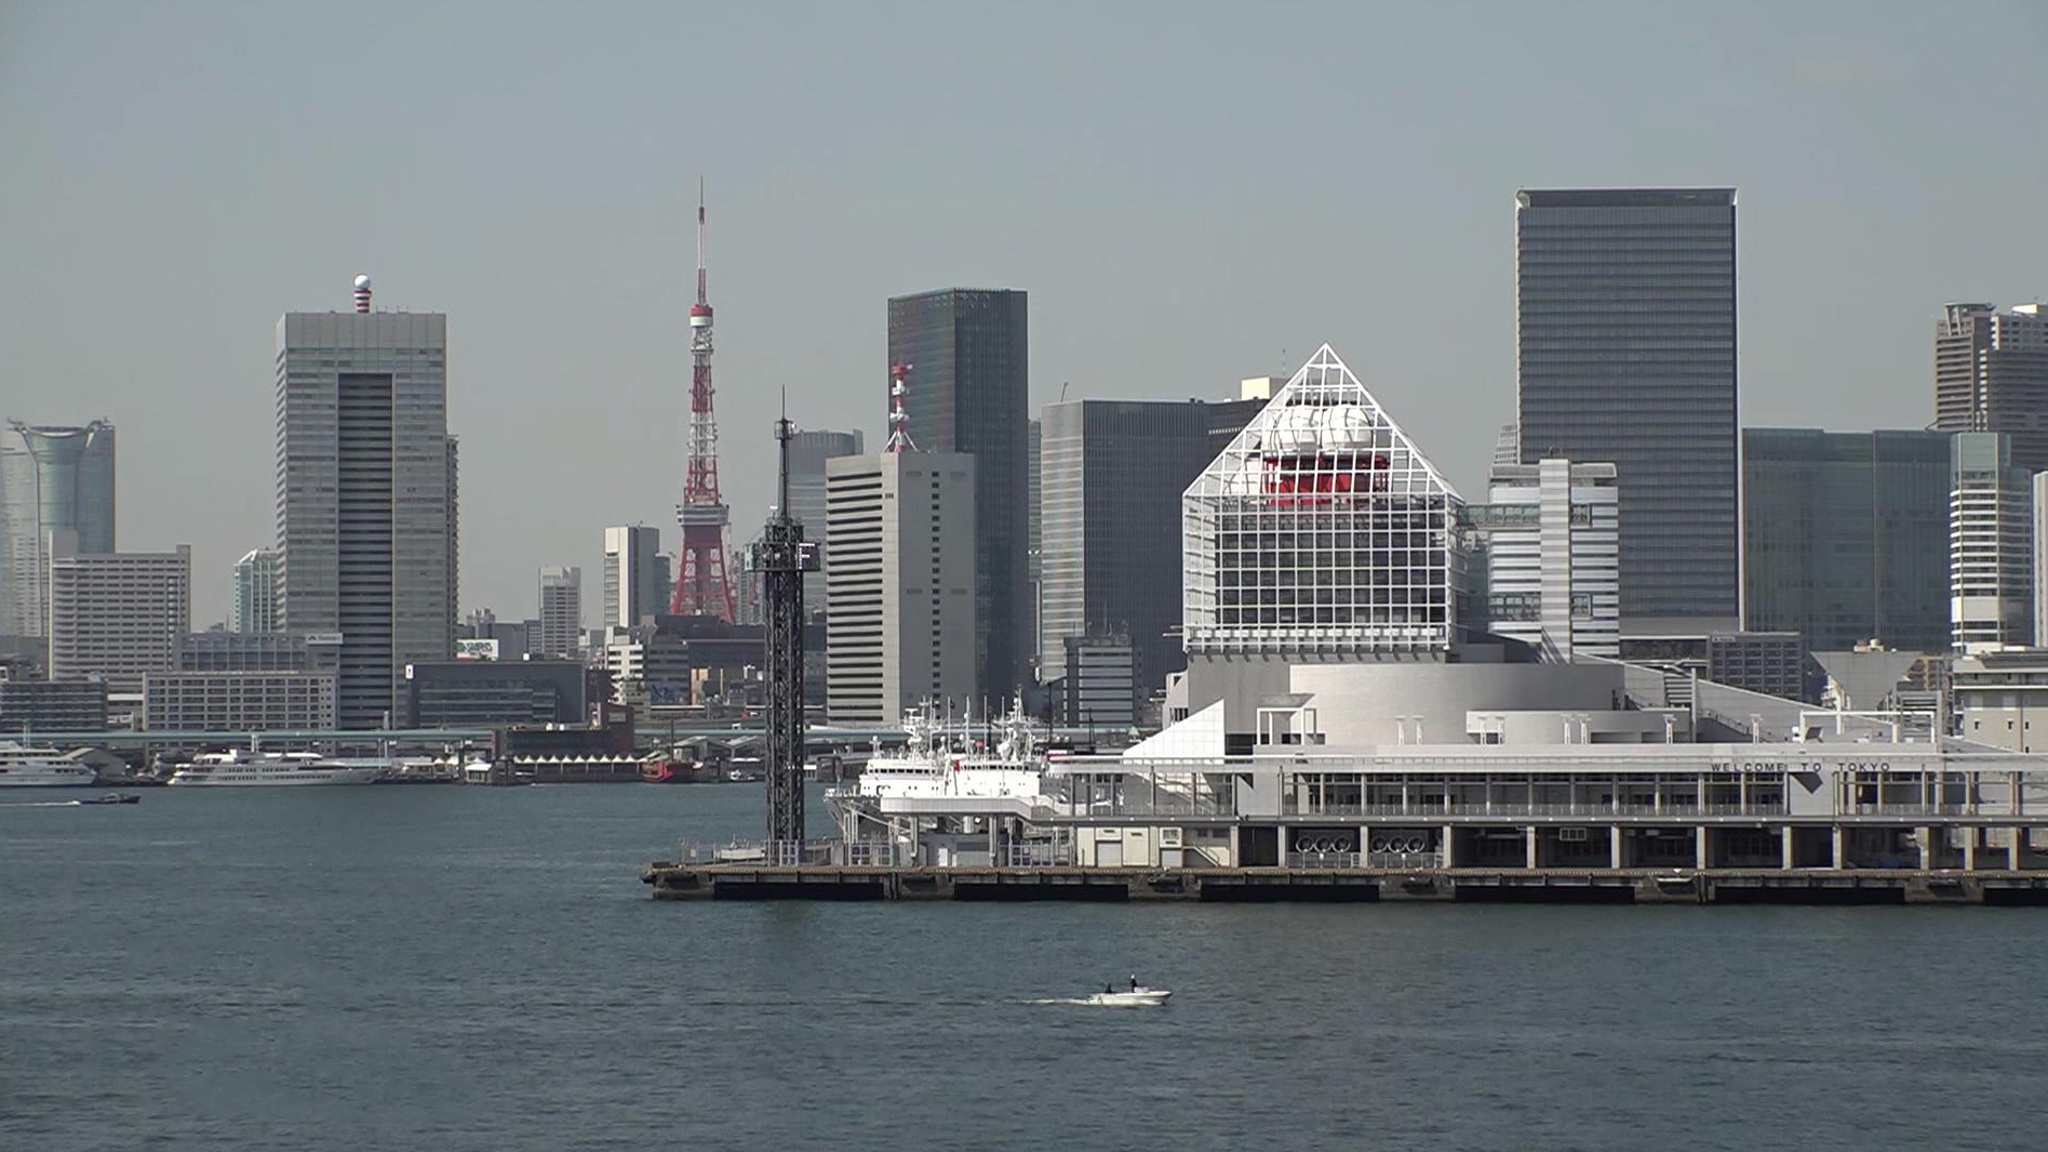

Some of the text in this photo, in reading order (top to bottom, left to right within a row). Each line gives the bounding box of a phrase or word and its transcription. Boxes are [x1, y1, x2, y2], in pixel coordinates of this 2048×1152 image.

[1711, 762, 1890, 772] WELCOME TO TOKYO
